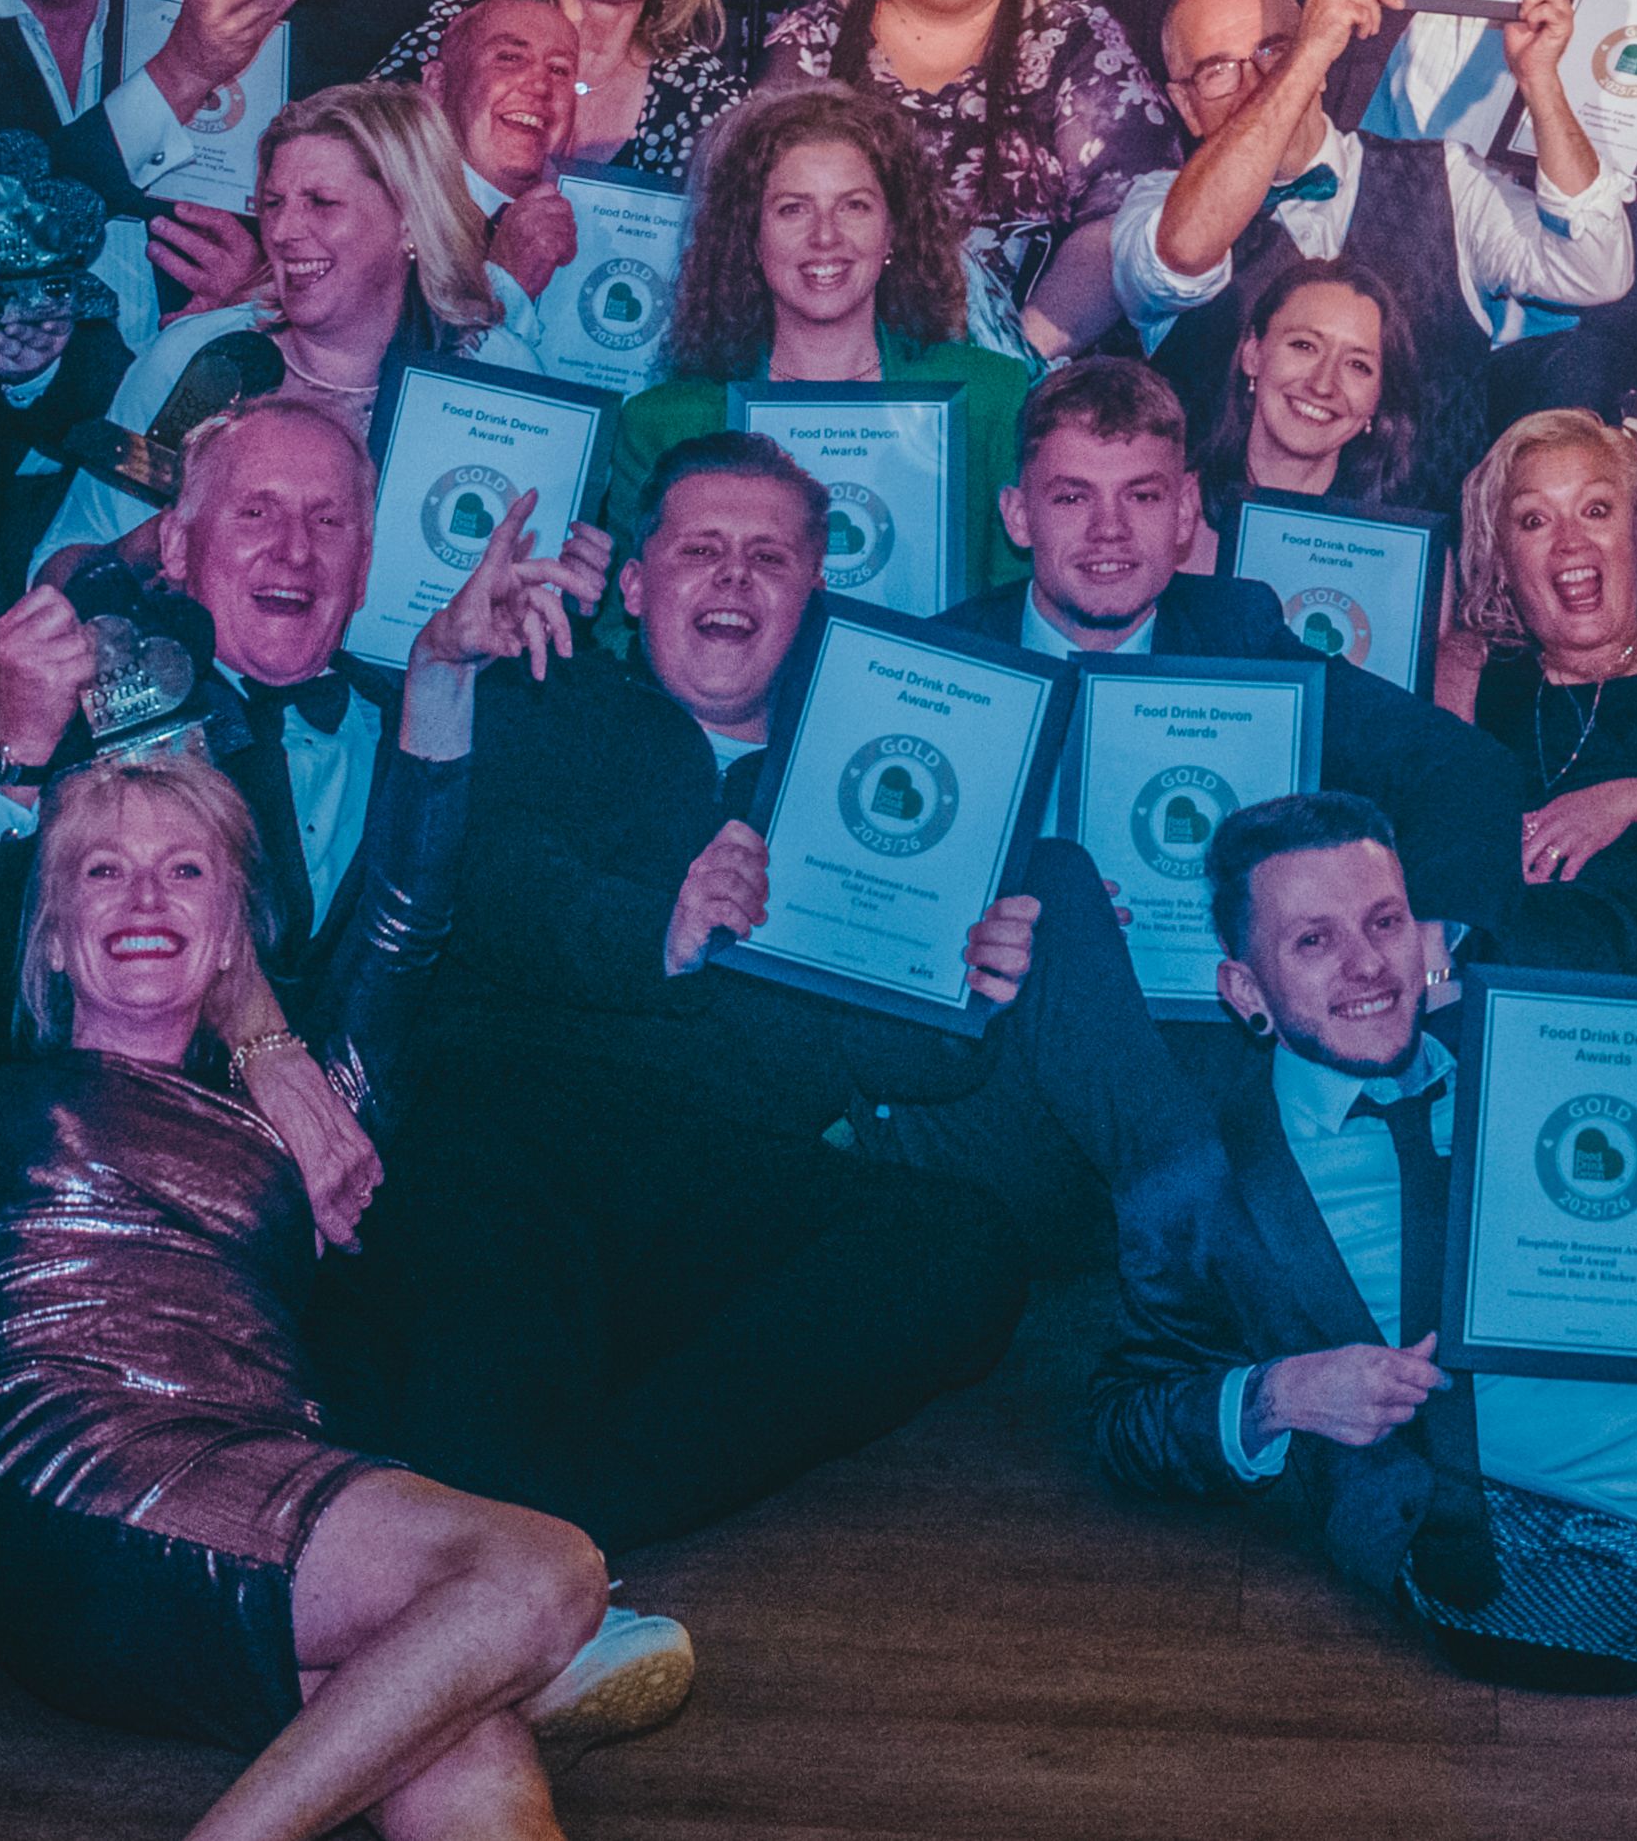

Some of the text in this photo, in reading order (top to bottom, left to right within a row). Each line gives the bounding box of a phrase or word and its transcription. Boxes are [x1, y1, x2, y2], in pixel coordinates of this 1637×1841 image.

[1538, 1023, 1577, 1041] Food
[1579, 1027, 1620, 1044] Drink
[1573, 1047, 1632, 1067] Awards
[1567, 1096, 1633, 1124] GOLD
[1556, 1190, 1631, 1218] 2025/26
[1516, 1235, 1569, 1251] Hospitality
[1569, 1240, 1623, 1255] Restaurant
[1558, 1253, 1617, 1268] Gold Award
[1567, 1267, 1586, 1279] Bar
[1587, 1269, 1597, 1280] &
